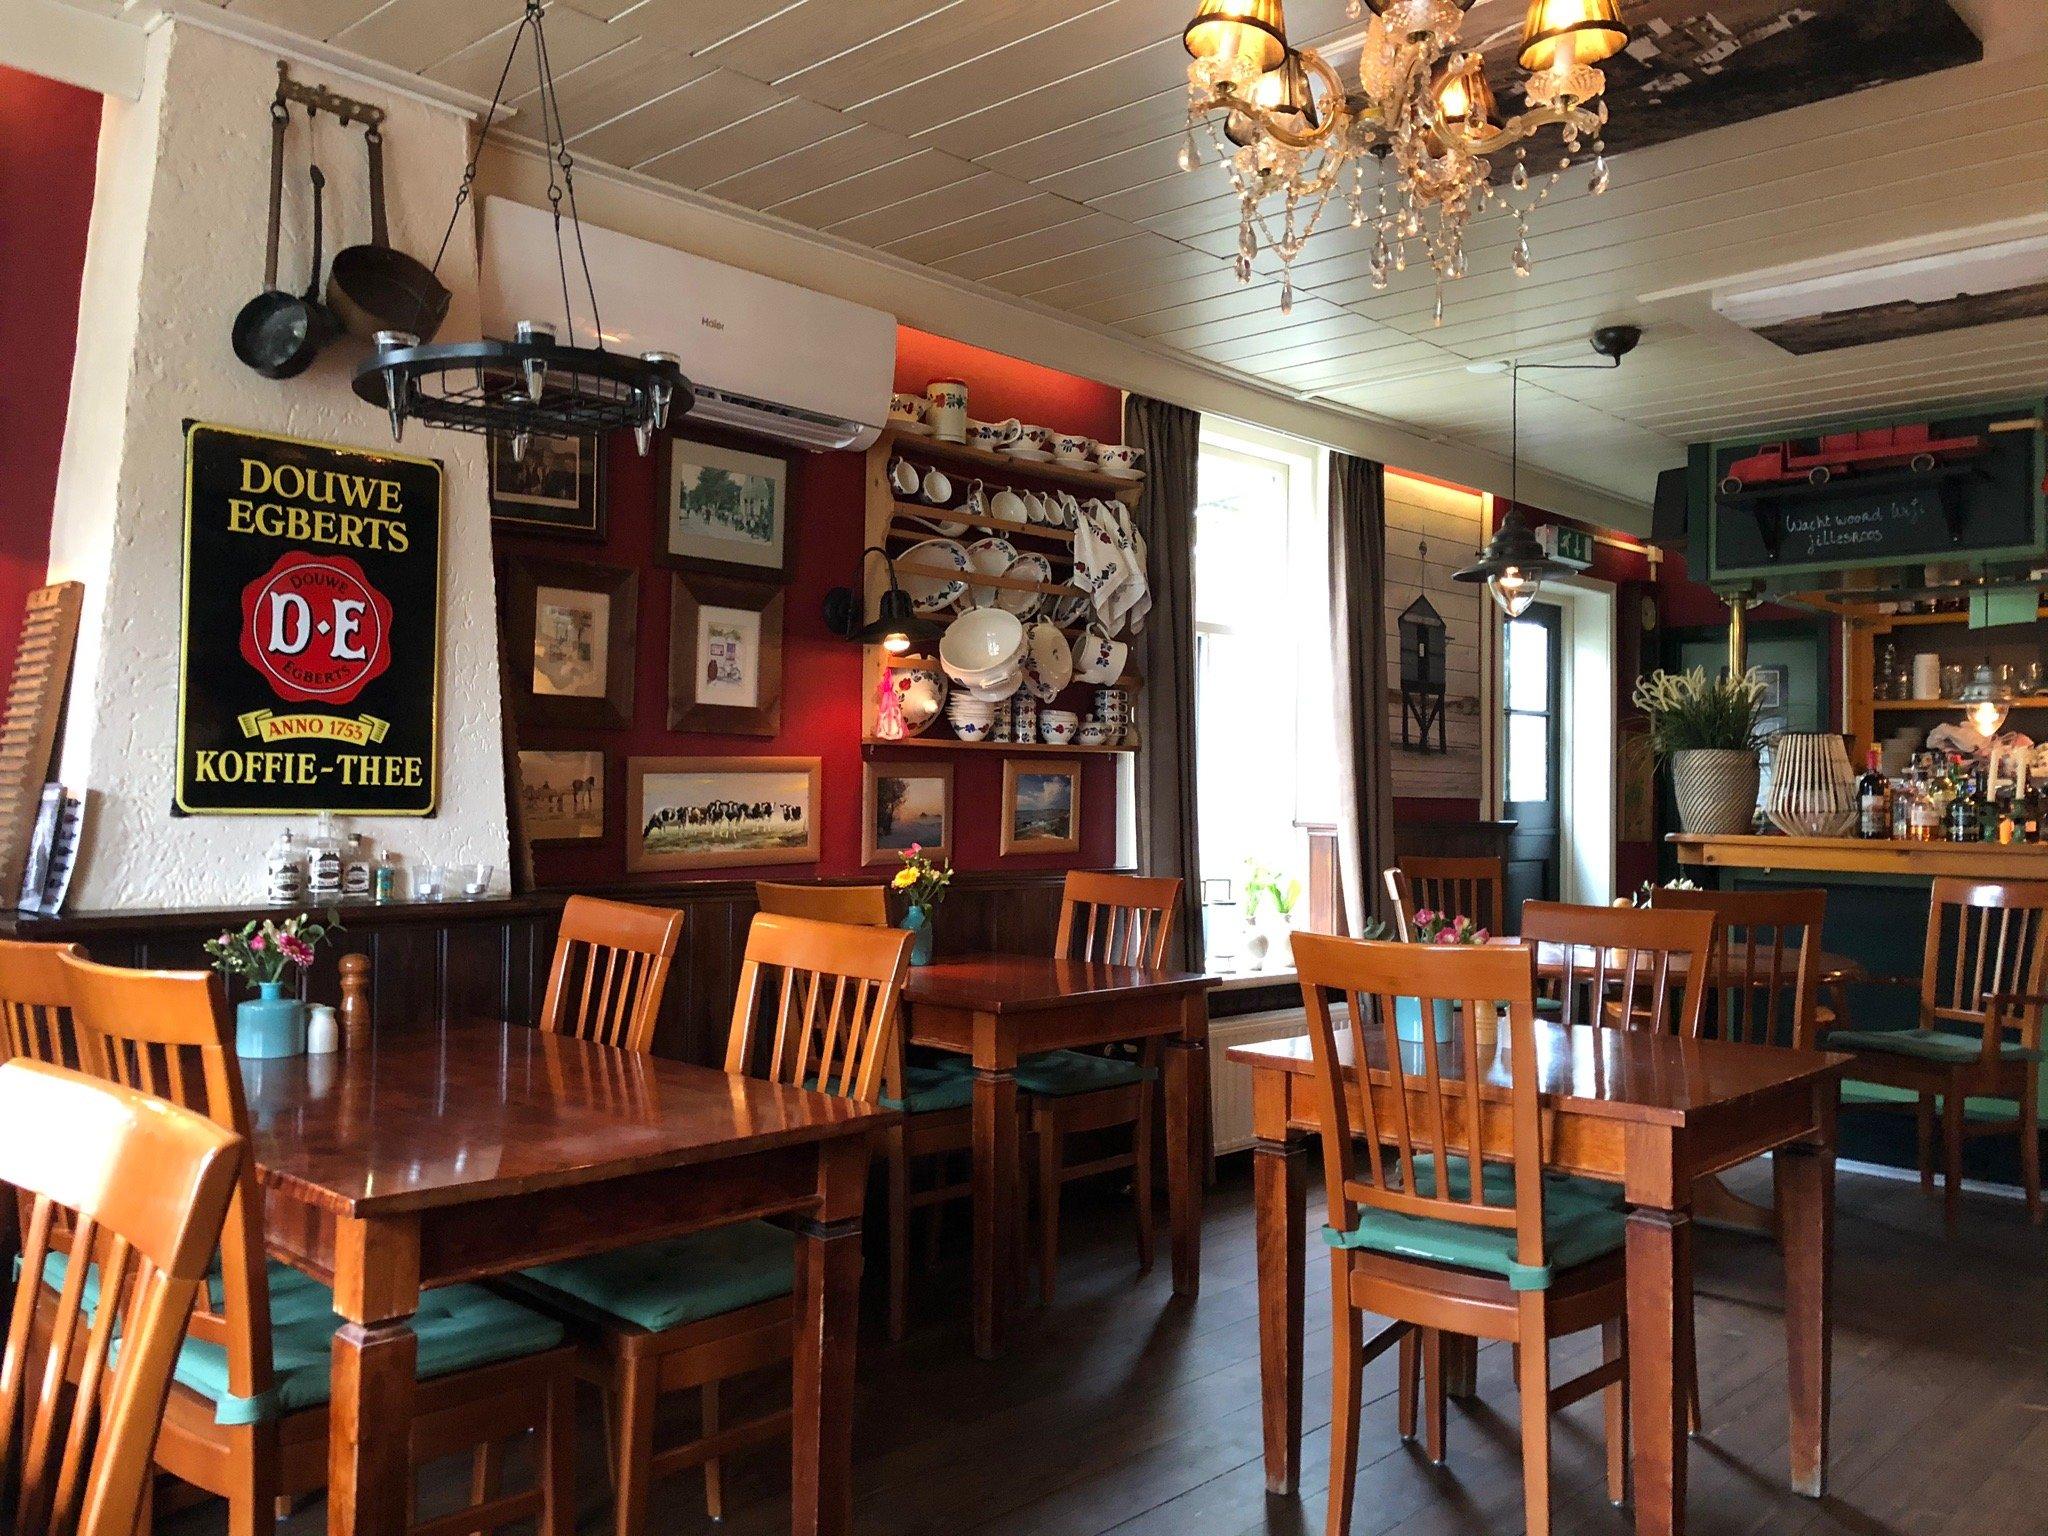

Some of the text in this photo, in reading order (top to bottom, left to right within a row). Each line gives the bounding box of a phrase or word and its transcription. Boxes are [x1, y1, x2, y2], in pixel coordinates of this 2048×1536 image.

[240, 458, 403, 513] DOUWE
[227, 498, 410, 553] EGBERTS
[290, 573, 348, 592] DOUWE
[283, 661, 351, 685] EGBERTS
[269, 718, 364, 741] ANNO 1753
[195, 750, 424, 787] KOFFIE-THEE
